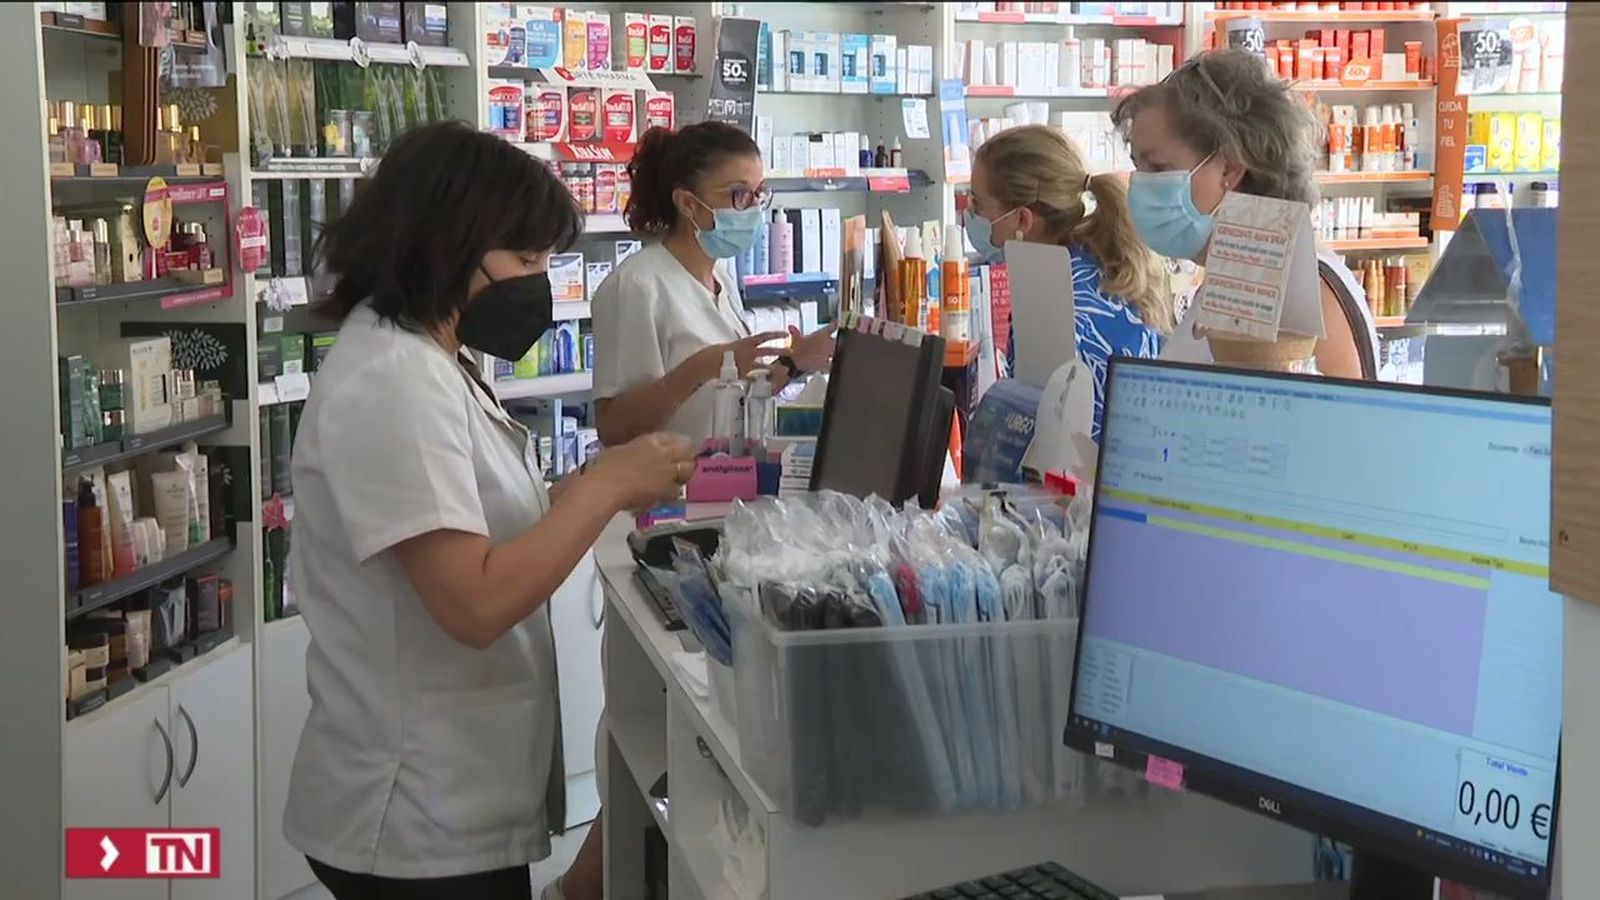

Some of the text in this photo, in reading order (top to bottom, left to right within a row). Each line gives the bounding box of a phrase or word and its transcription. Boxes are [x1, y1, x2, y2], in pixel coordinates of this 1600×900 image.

[1443, 118, 1455, 130] TU
[1008, 411, 1034, 435] URGO
[1161, 448, 1169, 463] 1
[1486, 757, 1505, 770] Total
[1258, 796, 1281, 814] DELL
[1459, 780, 1551, 840] 0,00 €
